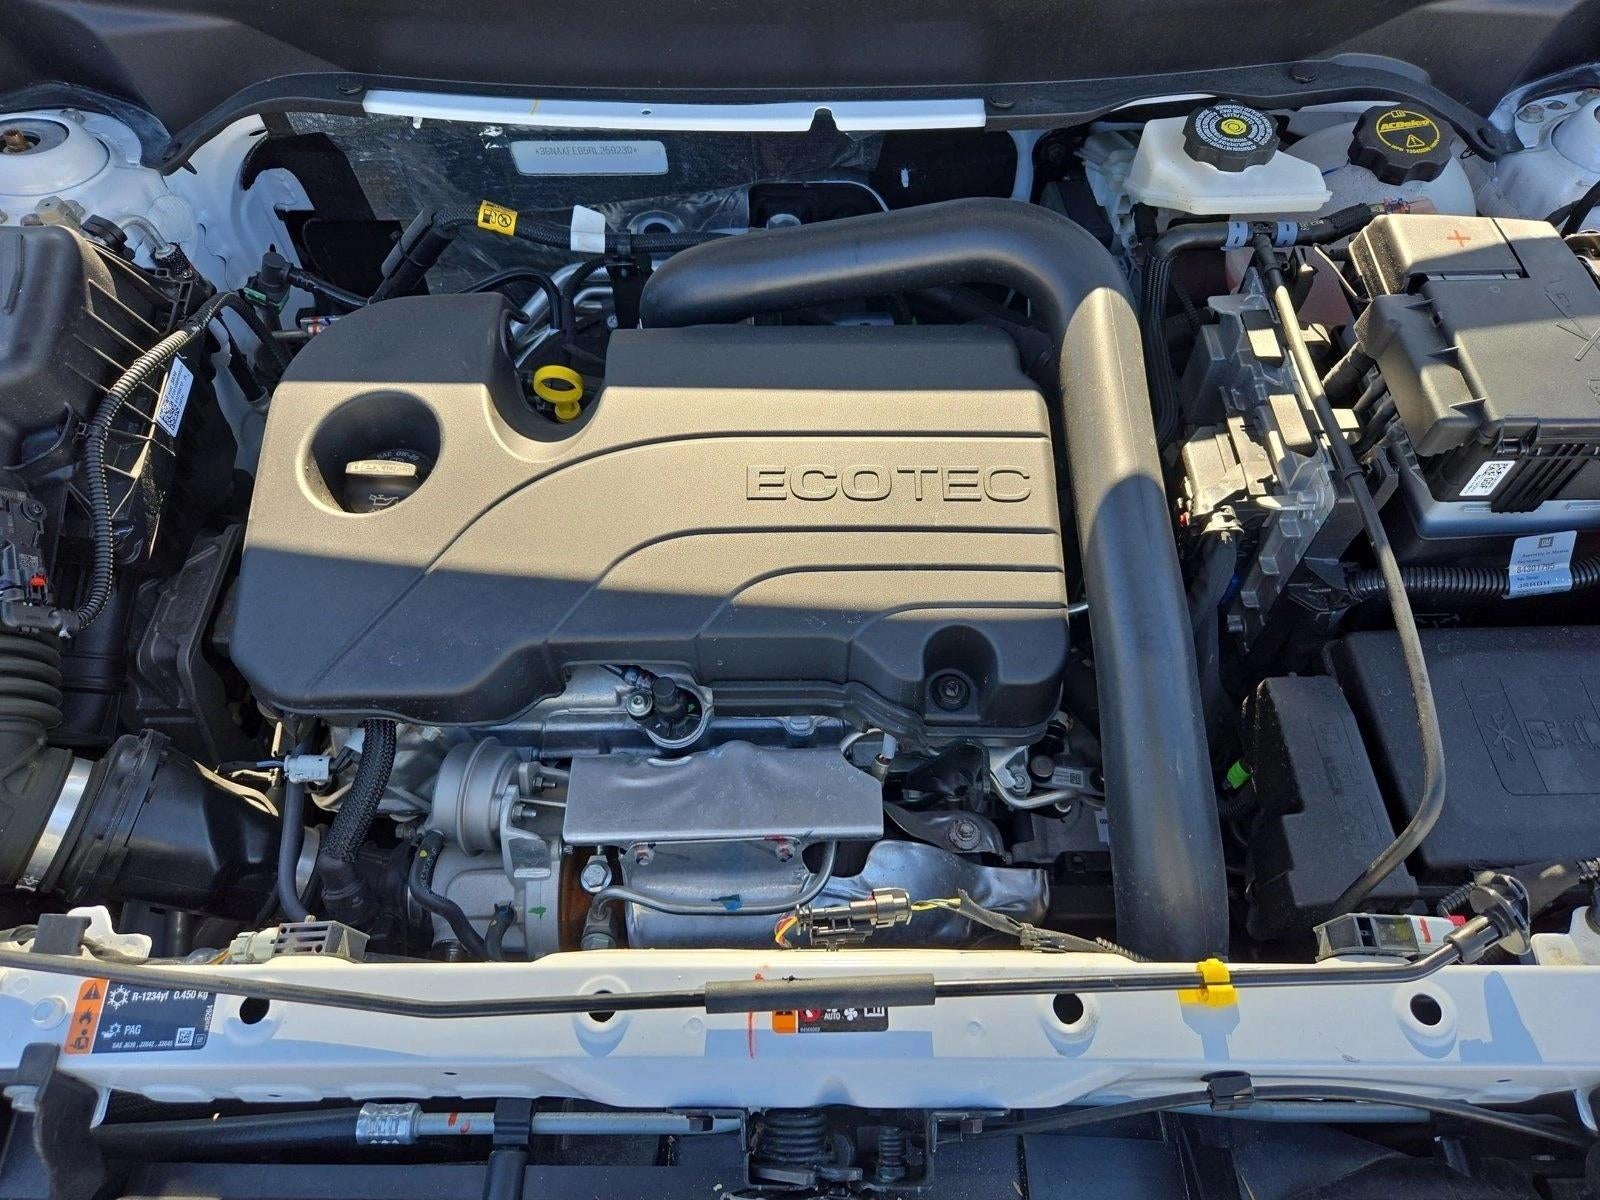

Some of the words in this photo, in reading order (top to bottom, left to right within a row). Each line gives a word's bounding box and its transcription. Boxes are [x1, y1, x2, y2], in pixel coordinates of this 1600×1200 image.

[746, 465, 1031, 502] ECOTEC
[132, 991, 168, 1002] R-1234yf
[173, 990, 197, 1000] 0.450
[824, 1012, 841, 1021] AUTO
[124, 1024, 142, 1035] PAG
